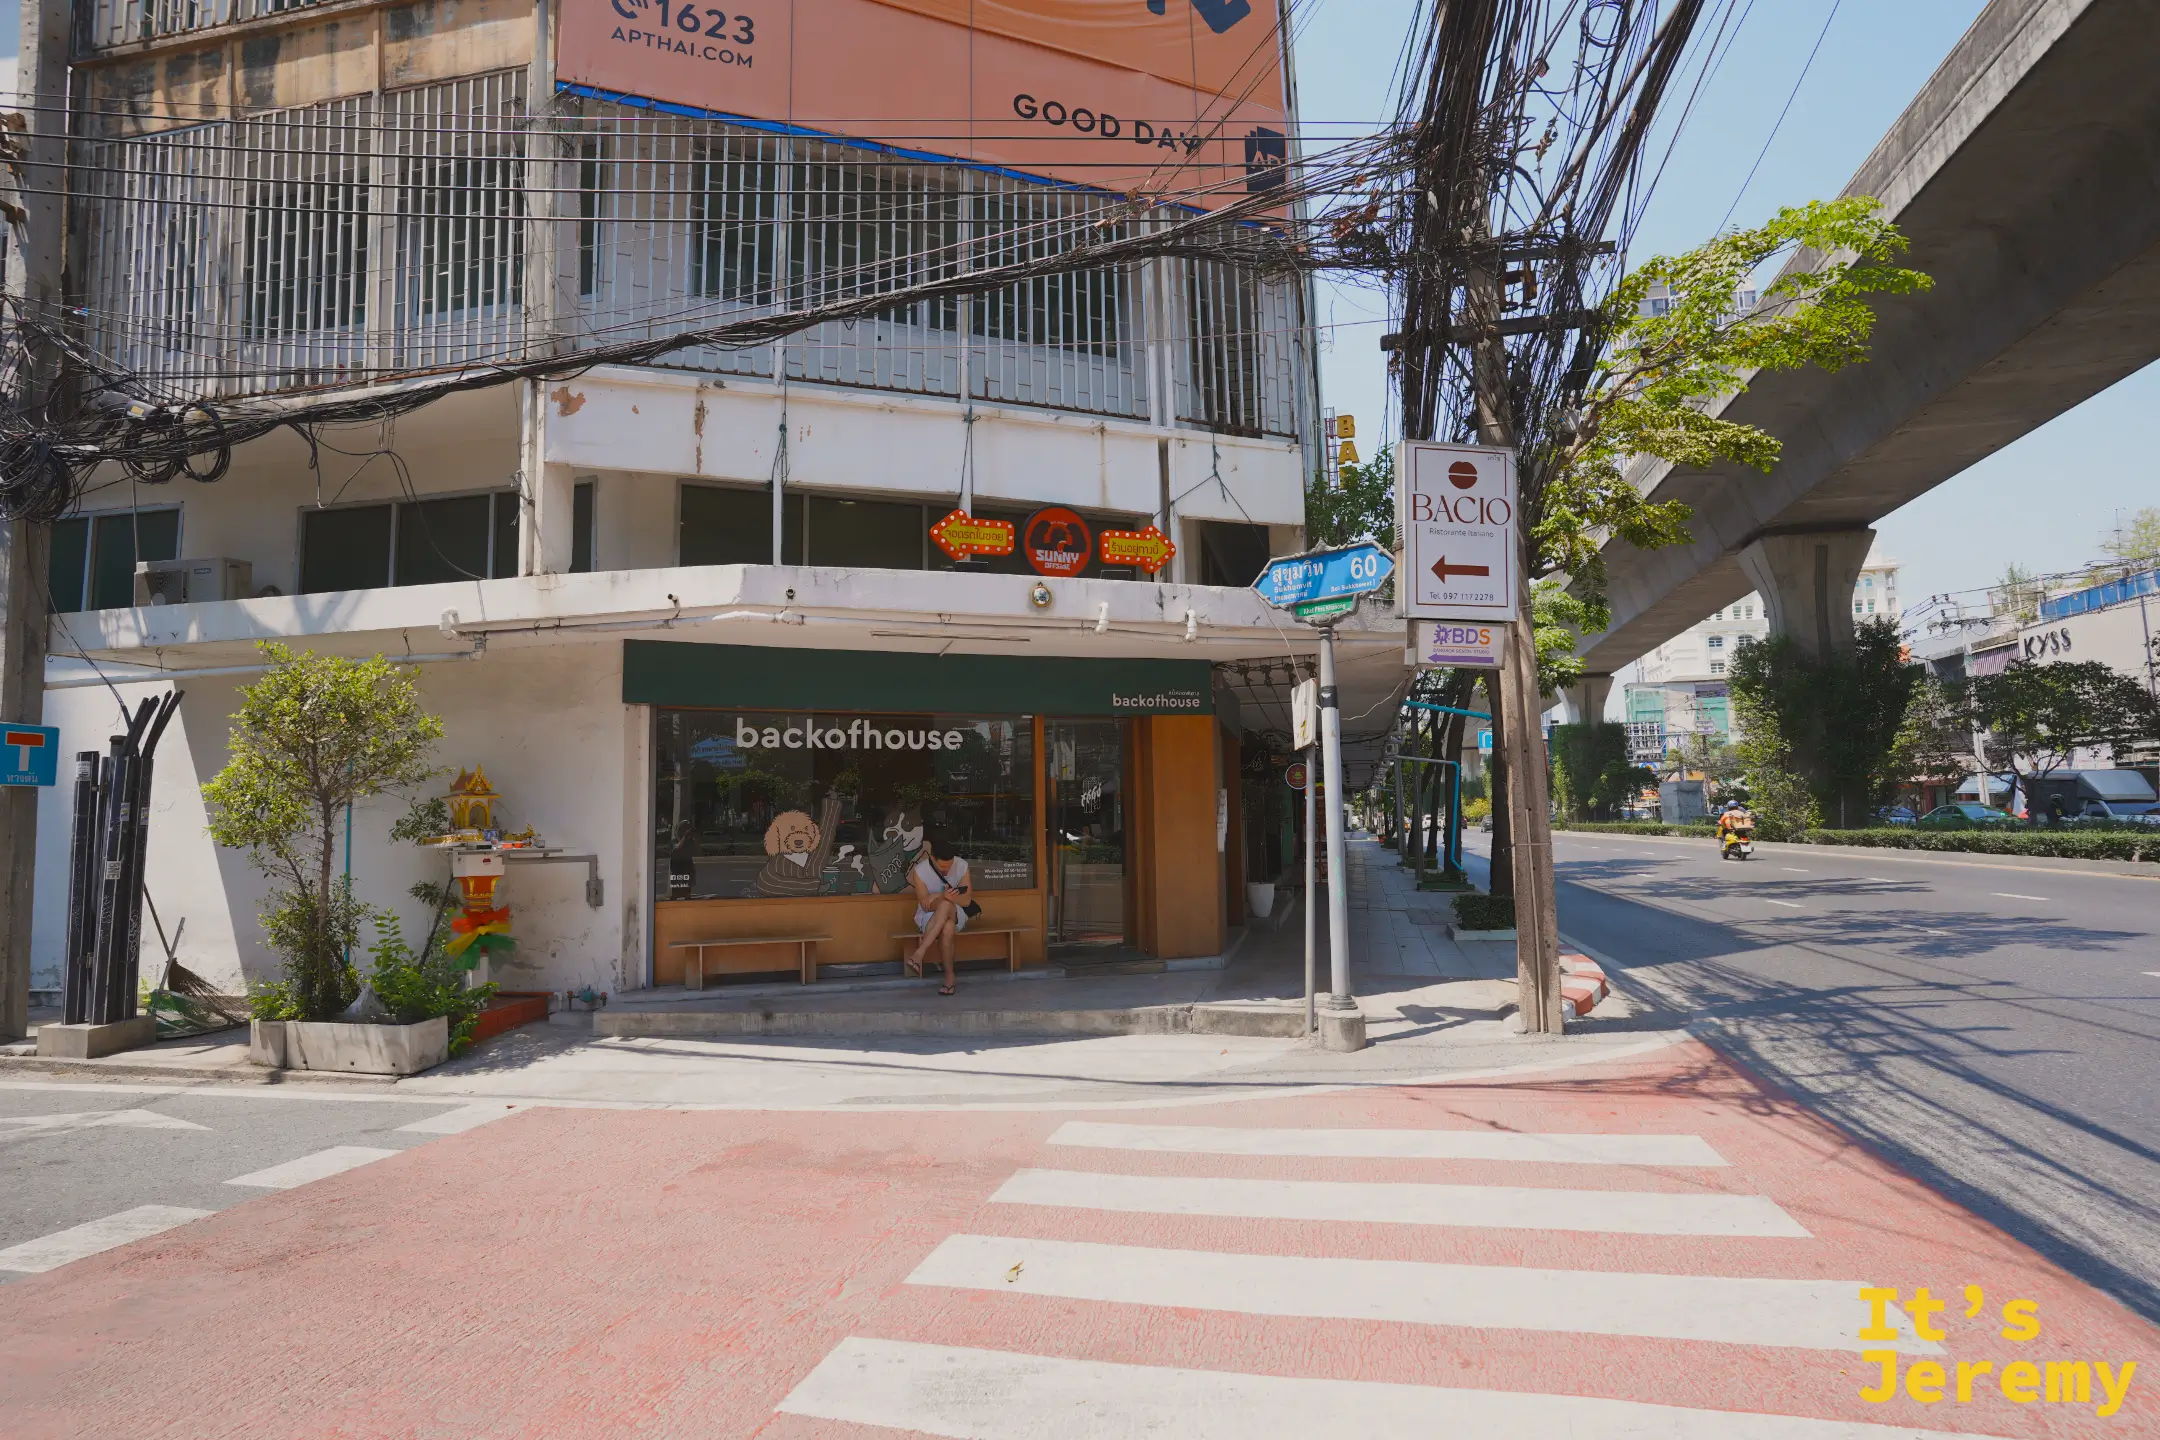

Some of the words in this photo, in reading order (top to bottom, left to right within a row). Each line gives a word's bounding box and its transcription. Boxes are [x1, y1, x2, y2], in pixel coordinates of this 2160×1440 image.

[655, 0, 754, 44] 1623
[611, 27, 753, 68] APTHAI.COM
[1013, 94, 1121, 137] GOOD
[1135, 120, 1199, 155] DAY
[1412, 494, 1511, 526] BACIO
[945, 528, 1004, 542] จอดรถในซอย
[1429, 528, 1466, 536] Ristorante
[1468, 529, 1494, 537] Italiano
[1036, 549, 1079, 564] SUNNY
[1112, 540, 1159, 556] ร้านอยู่ทางนี้
[1273, 560, 1323, 587] สุขุมวิท
[1351, 554, 1377, 579] 60
[1274, 581, 1312, 593] Sukhumvit
[1443, 592, 1458, 600] 097
[1452, 628, 1491, 645] BDS
[2024, 627, 2072, 657] KYSS
[1112, 693, 1200, 707] backofhouse
[736, 717, 964, 750] backofhouse
